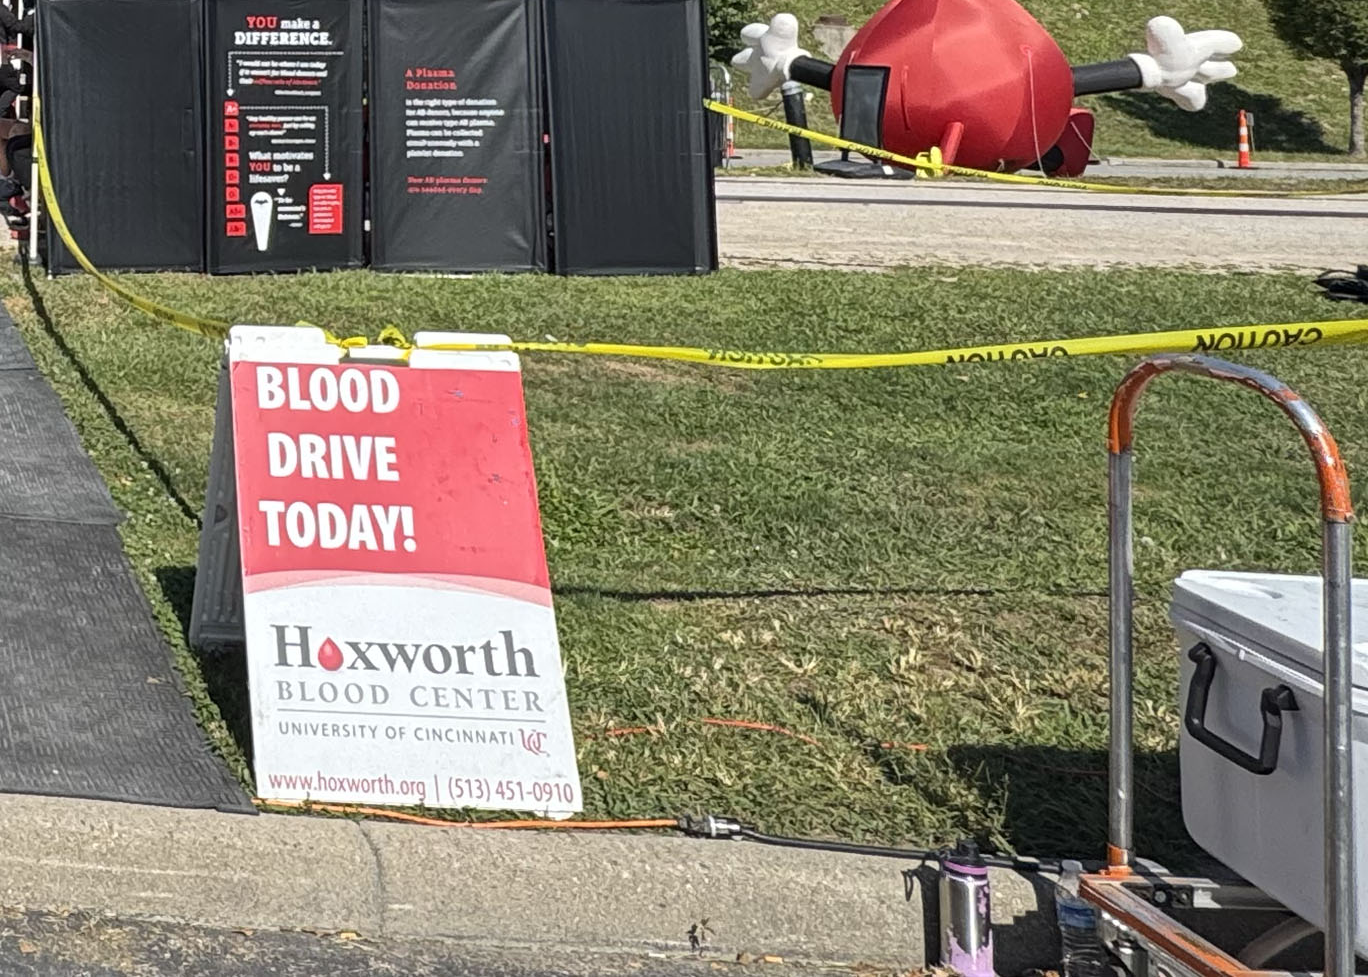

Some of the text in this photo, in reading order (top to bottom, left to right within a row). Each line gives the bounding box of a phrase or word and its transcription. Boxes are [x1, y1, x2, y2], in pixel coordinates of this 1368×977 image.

[246, 16, 320, 30] YOU make a
[234, 32, 333, 45] DIFFERENCE.
[405, 68, 455, 77] A Plasma
[406, 80, 457, 90] Donation
[249, 162, 272, 172] YOU
[1196, 326, 1324, 352] CAUTION
[256, 365, 400, 413] BLOOD
[267, 432, 400, 481] DRIVE
[258, 500, 417, 552] TODAY!
[276, 680, 544, 712] BLOOD CENTER
[279, 721, 378, 739] UNIVERSITY
[385, 725, 406, 740] OF
[414, 726, 514, 746] CINCINNATI
[269, 771, 574, 804] www.hoxworth.org (513) 451-0910
